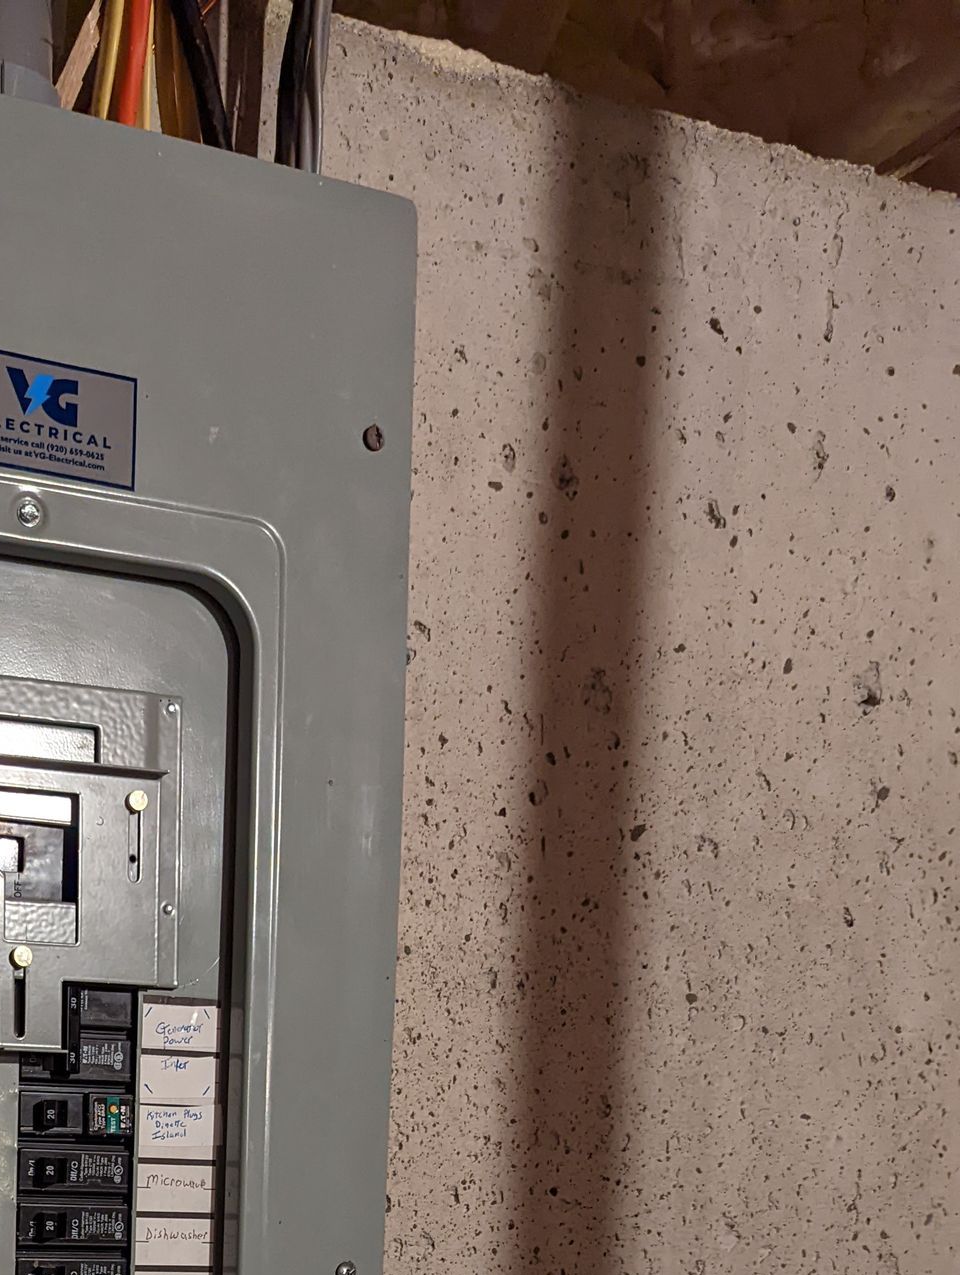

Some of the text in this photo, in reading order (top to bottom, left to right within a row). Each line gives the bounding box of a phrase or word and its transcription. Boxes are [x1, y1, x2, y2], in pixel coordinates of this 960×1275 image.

[1, 435, 29, 447] service
[31, 438, 45, 449] call
[47, 440, 67, 455] (920)
[70, 446, 104, 461] 659-0625
[14, 448, 22, 456] us
[34, 451, 104, 471] VG-Electrical.com
[70, 997, 77, 1009] 30
[47, 1109, 55, 1120] 20
[146, 1111, 177, 1120] Kitchen
[151, 1129, 186, 1140] Island
[46, 1165, 54, 1176] 20
[146, 1174, 206, 1189] Microwave
[46, 1221, 54, 1231] 20
[146, 1228, 208, 1241] Dishwasher
